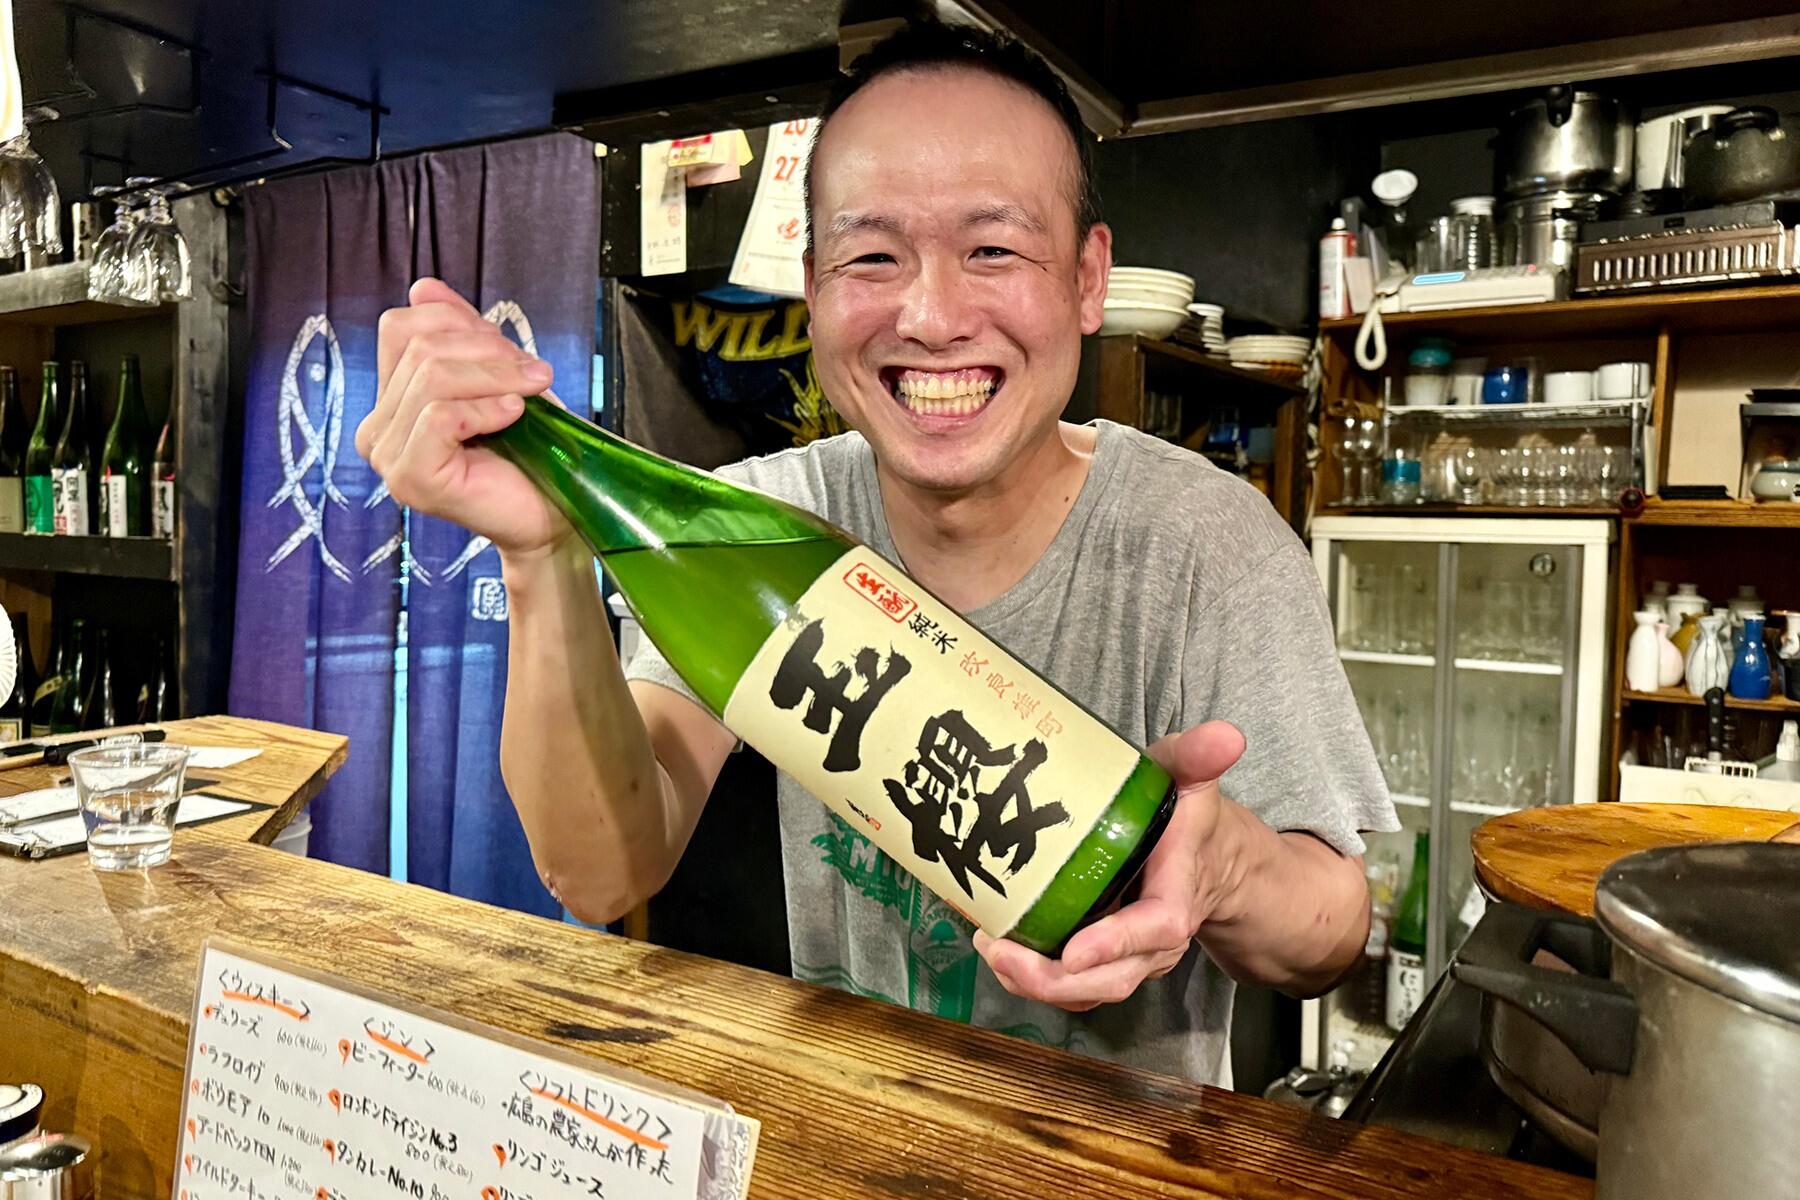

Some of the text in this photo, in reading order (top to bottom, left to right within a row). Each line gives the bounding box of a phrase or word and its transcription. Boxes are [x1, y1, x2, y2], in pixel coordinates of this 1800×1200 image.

[774, 156, 799, 181] 27
[906, 612, 959, 654] 純米
[959, 650, 1064, 738] 改良雄町
[202, 1077, 252, 1118] ボウモア
[257, 1105, 270, 1125] 10
